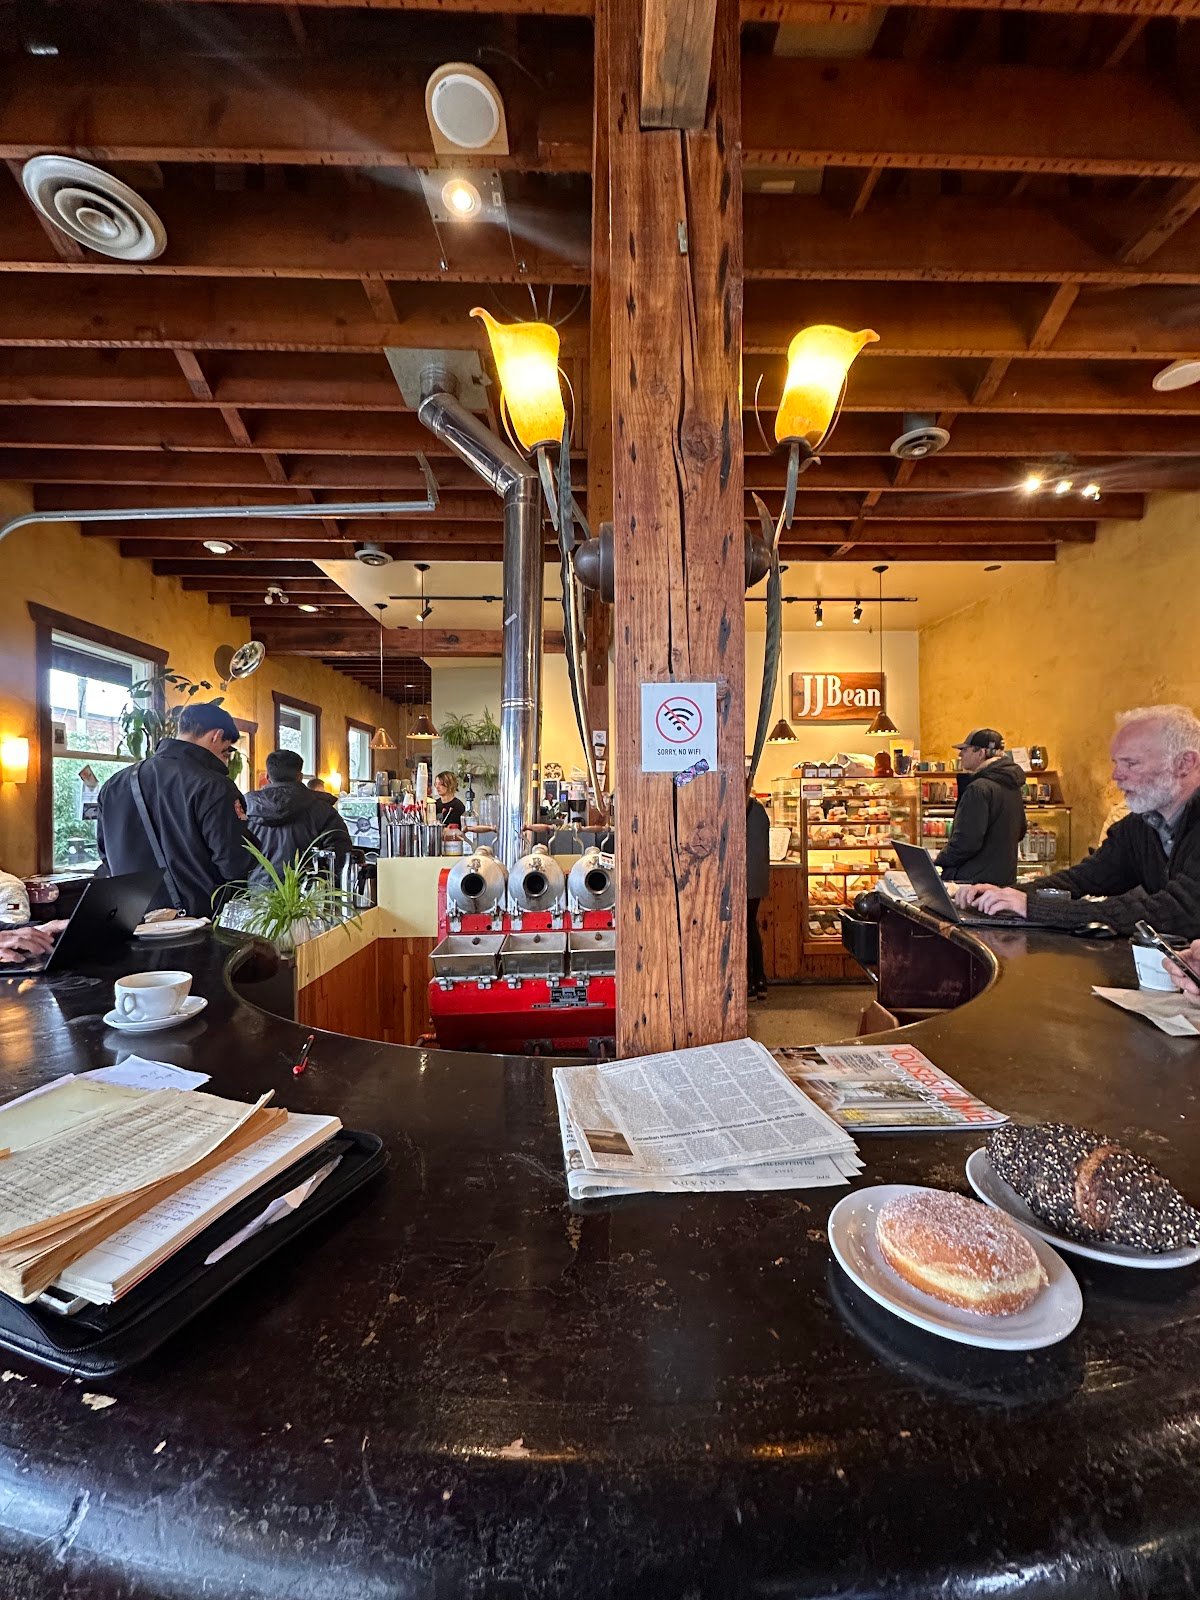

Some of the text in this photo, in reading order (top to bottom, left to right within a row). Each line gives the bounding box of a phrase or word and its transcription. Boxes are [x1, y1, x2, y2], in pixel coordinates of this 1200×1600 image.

[657, 748, 701, 756] SORRY, NO WIFI
[671, 1179, 727, 1187] CANADA
